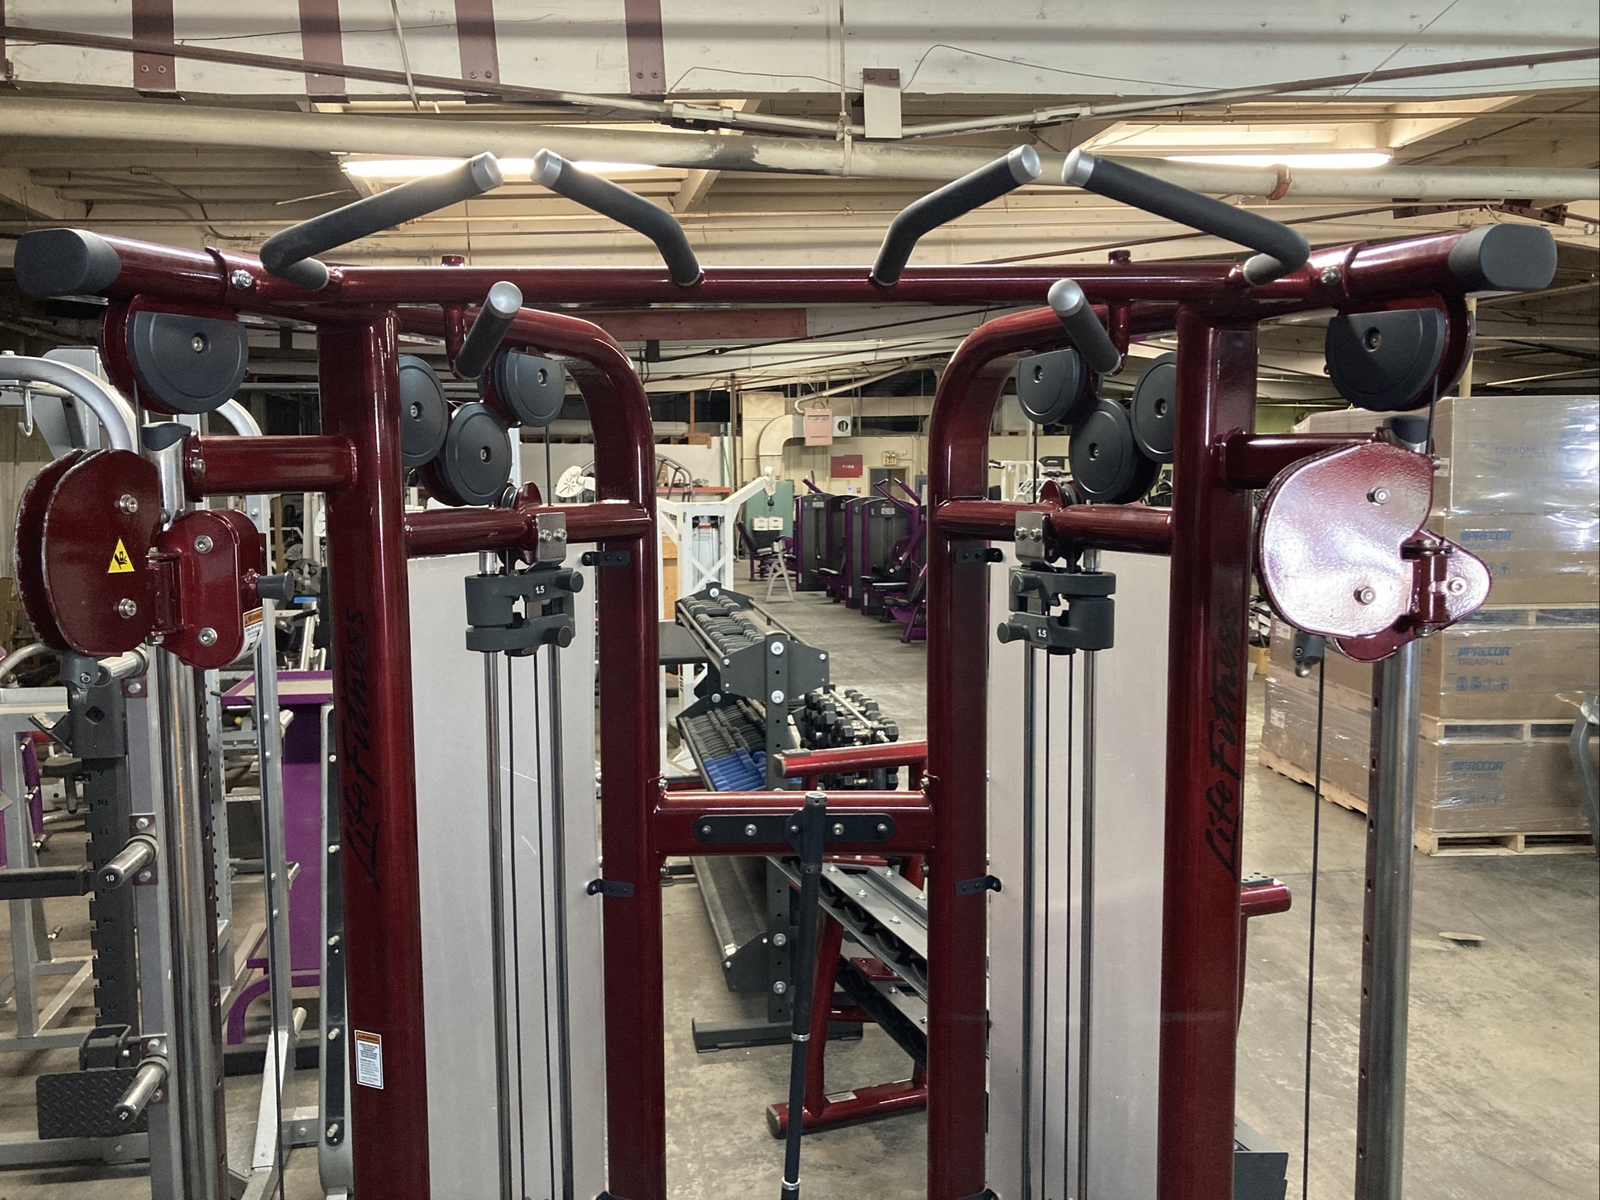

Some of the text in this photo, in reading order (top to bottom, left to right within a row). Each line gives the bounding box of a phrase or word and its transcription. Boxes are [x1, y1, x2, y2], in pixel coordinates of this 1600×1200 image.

[1495, 446, 1548, 455] TREADMILL
[535, 585, 545, 594] 1.5
[1037, 628, 1047, 638] 1.5
[1465, 646, 1512, 657] PRECOR
[1458, 658, 1506, 666] TREADMILL
[105, 874, 115, 882] 10
